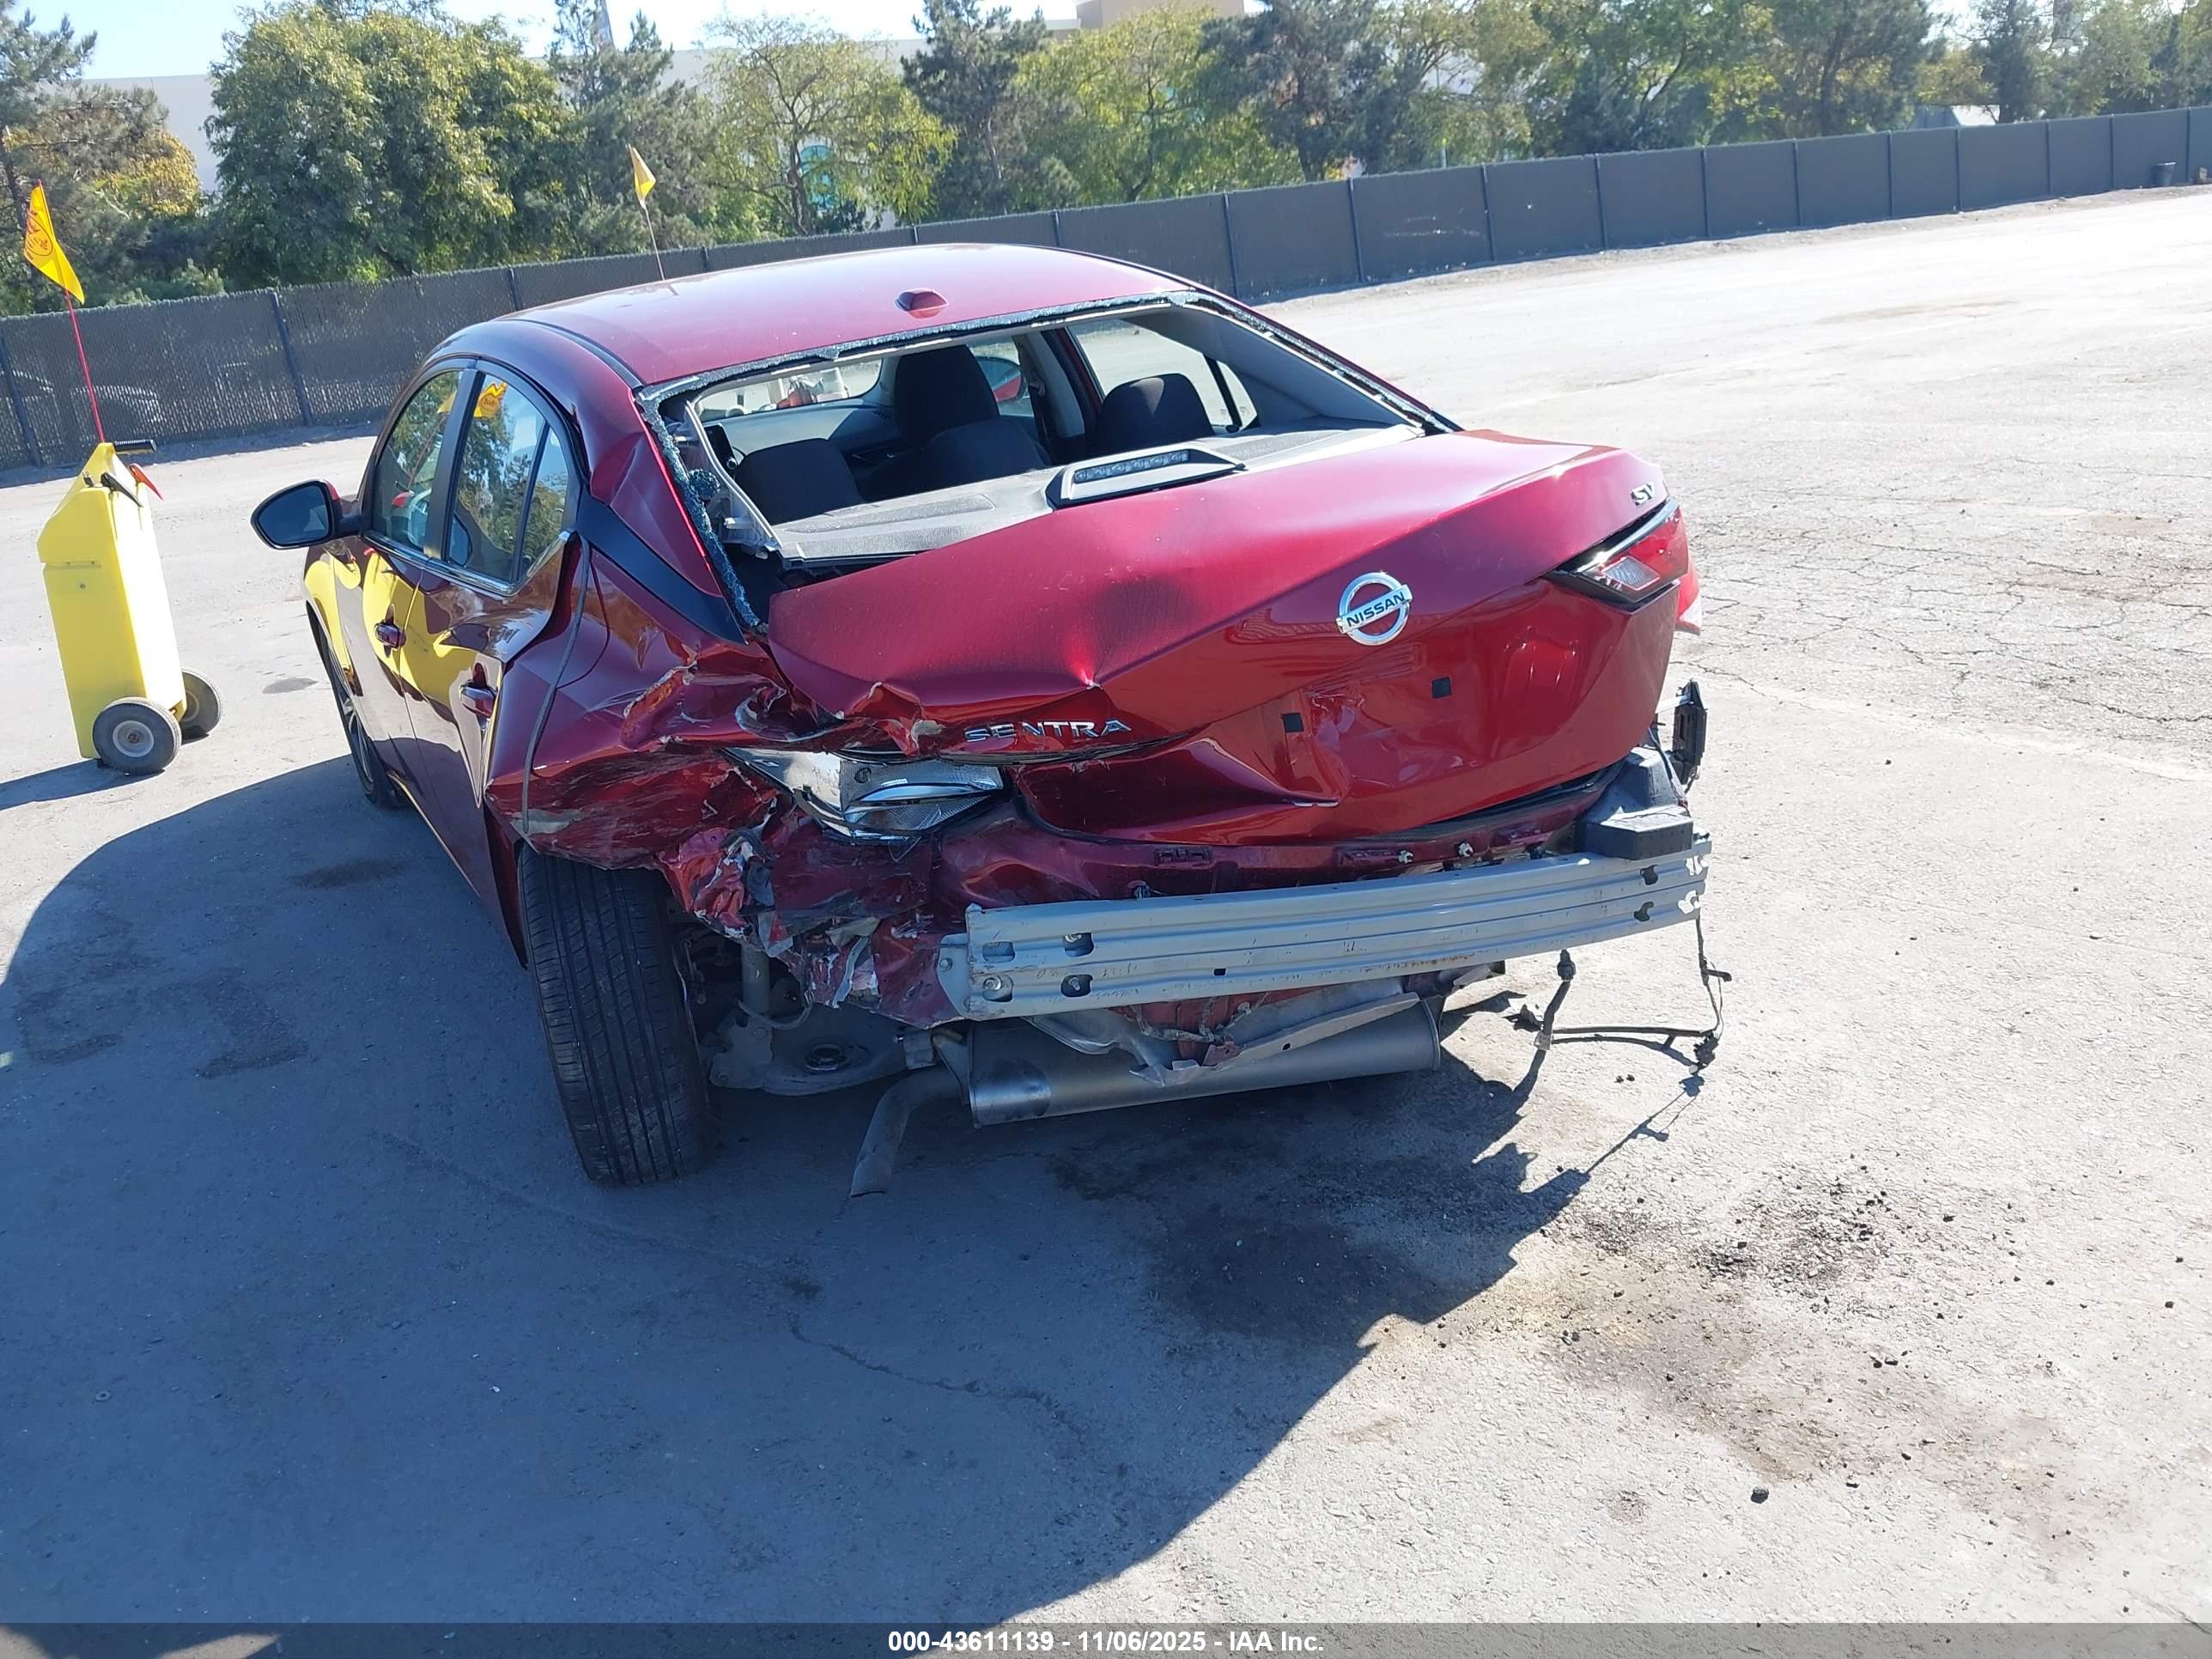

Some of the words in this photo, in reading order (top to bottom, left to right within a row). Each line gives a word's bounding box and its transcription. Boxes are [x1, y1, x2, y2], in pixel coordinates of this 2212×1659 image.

[1631, 481, 1656, 507] SV
[1346, 592, 1406, 628] NISSAN
[964, 720, 1132, 742] SENTRA
